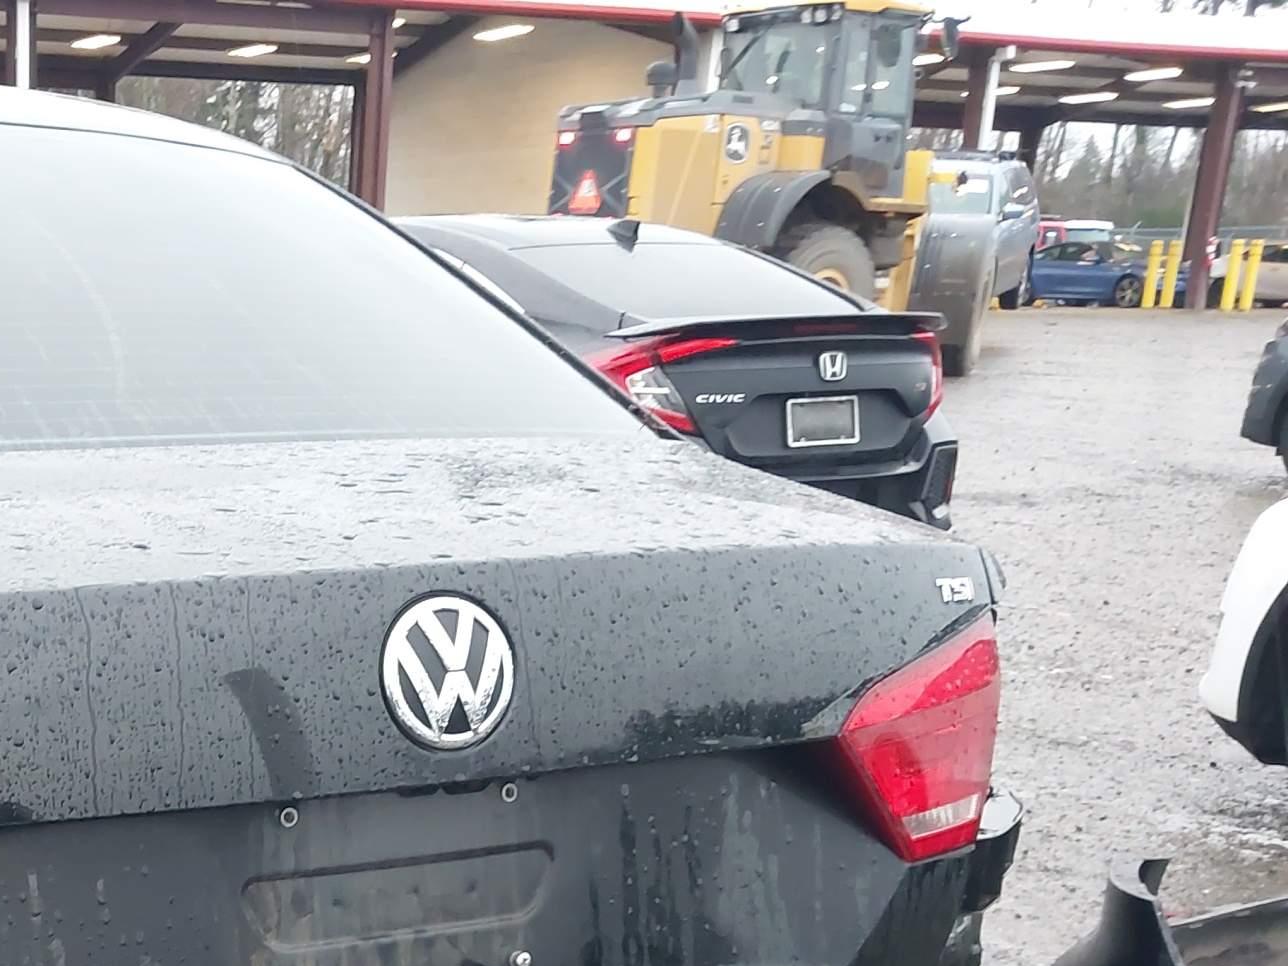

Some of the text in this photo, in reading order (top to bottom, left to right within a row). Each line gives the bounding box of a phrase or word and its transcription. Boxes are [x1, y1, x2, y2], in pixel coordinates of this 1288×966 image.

[695, 393, 746, 404] CIVIC
[935, 577, 975, 603] TSI
[385, 598, 512, 742] VW
